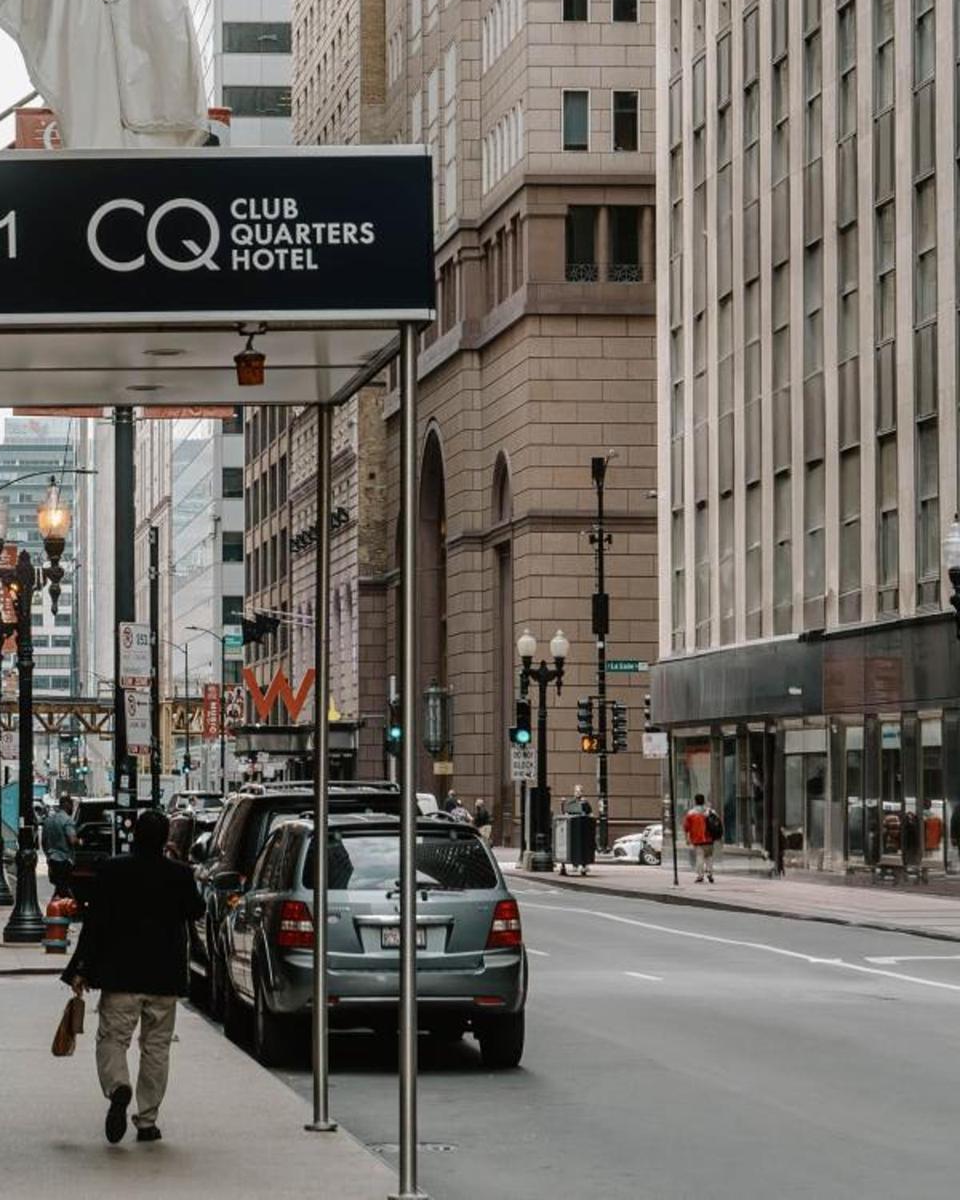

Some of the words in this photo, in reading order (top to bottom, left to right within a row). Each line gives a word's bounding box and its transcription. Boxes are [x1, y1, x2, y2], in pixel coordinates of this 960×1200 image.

[230, 197, 299, 220] CLUB
[87, 197, 221, 272] CQ
[230, 221, 376, 246] QUARTERS
[231, 248, 319, 271] HOTEL
[242, 664, 316, 722] W
